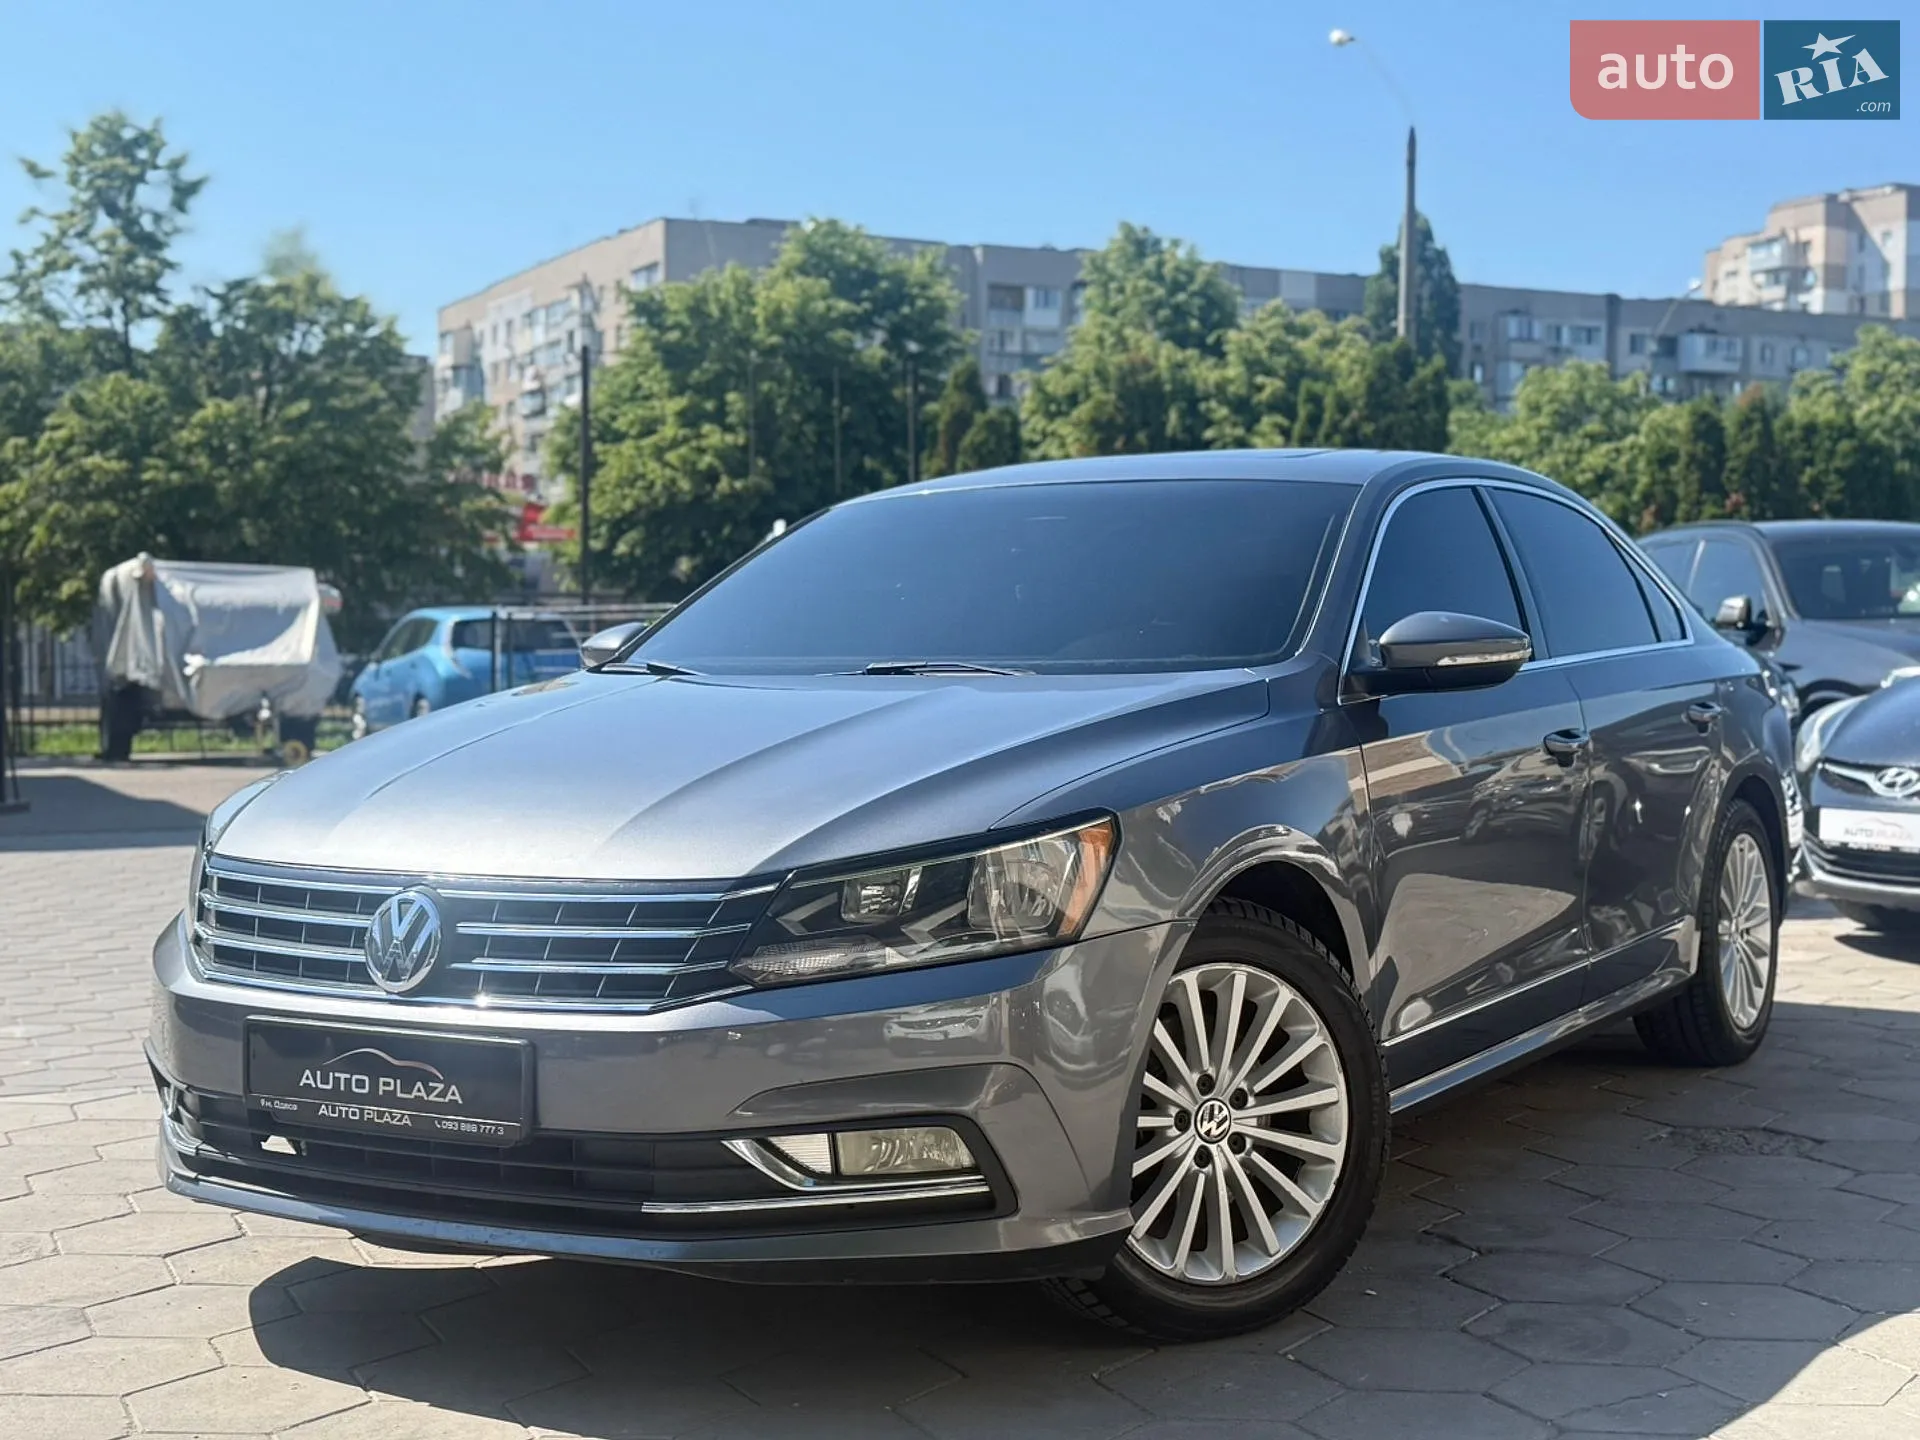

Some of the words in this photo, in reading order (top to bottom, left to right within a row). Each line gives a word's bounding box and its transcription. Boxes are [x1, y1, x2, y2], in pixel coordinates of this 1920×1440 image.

[299, 1069, 369, 1093] AUTO
[378, 1077, 463, 1104] PLAZA
[318, 1104, 360, 1120] AUTO
[363, 1110, 412, 1127] PLAZA
